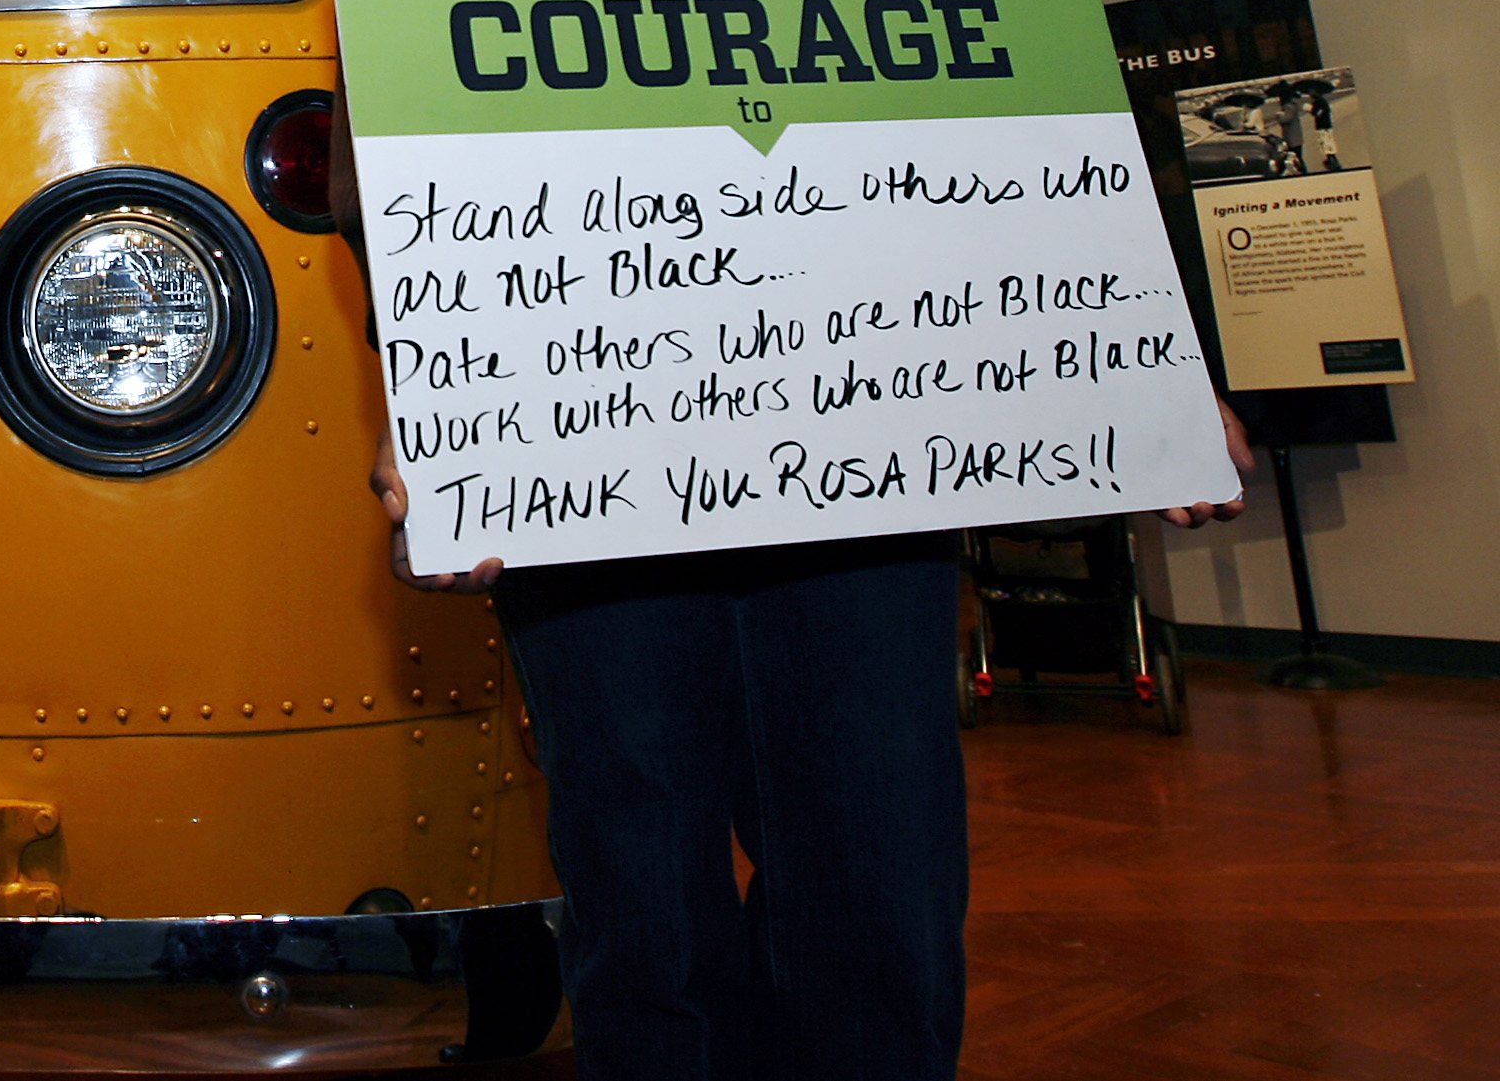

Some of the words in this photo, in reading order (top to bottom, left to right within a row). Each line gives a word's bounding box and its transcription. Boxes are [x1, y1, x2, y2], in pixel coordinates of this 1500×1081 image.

[1166, 45, 1217, 66] BUS
[736, 95, 774, 125] to
[862, 161, 1025, 205] others
[1043, 155, 1131, 200] who
[1213, 202, 1268, 218] Igniting
[1272, 201, 1281, 210] a
[1285, 192, 1361, 209] Movement
[393, 270, 481, 322] are
[496, 255, 586, 310] not
[386, 337, 518, 396] Date
[546, 325, 695, 376] others
[719, 309, 806, 365] who
[827, 300, 901, 345] are
[913, 281, 984, 329] not
[553, 381, 656, 440] with
[670, 372, 792, 424] others
[976, 348, 1038, 393] not
[434, 468, 639, 542] THANK
[768, 440, 907, 510] ROSA
[924, 424, 1122, 494] PARKS!!
